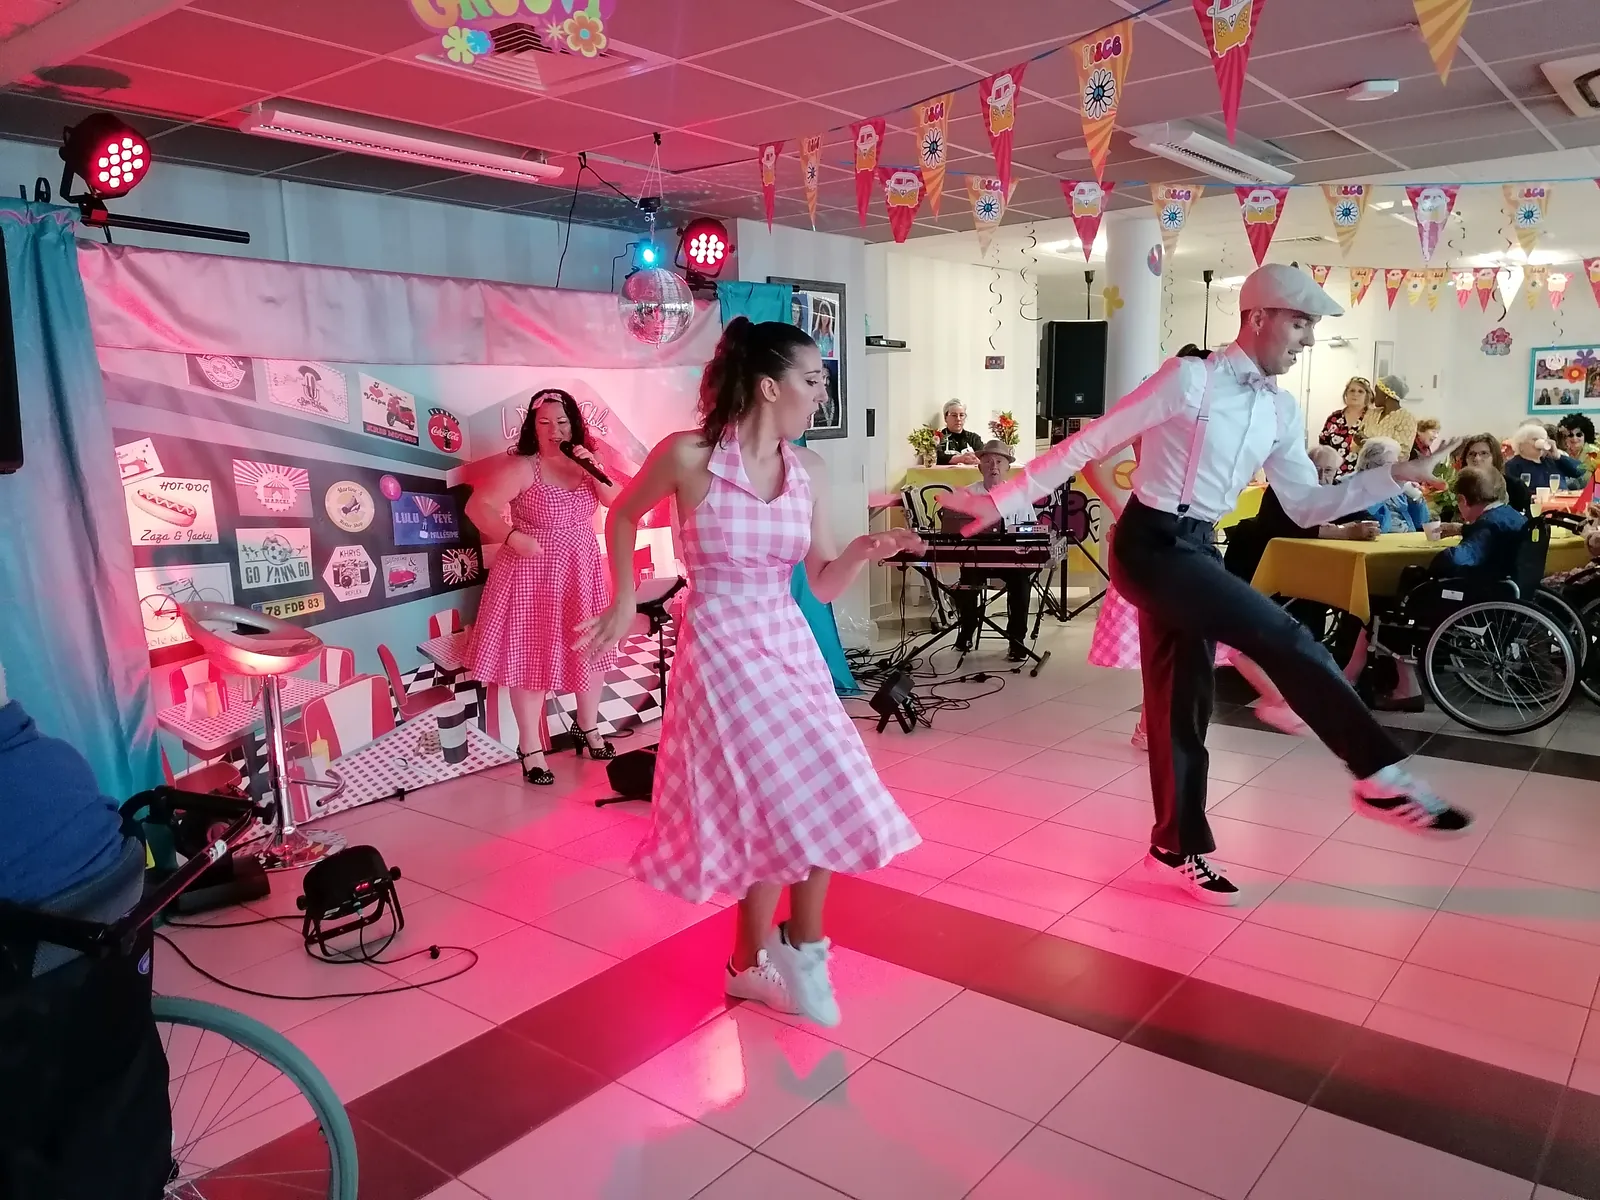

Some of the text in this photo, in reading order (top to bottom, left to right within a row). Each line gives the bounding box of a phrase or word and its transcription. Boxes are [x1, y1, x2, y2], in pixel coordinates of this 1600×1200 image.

[159, 481, 210, 494] HOT-DOG
[395, 511, 421, 524] LULU
[140, 529, 213, 544] Zaza & Jacky
[245, 561, 310, 584] GO YANN GO
[265, 598, 320, 616] 78 FDB 83
